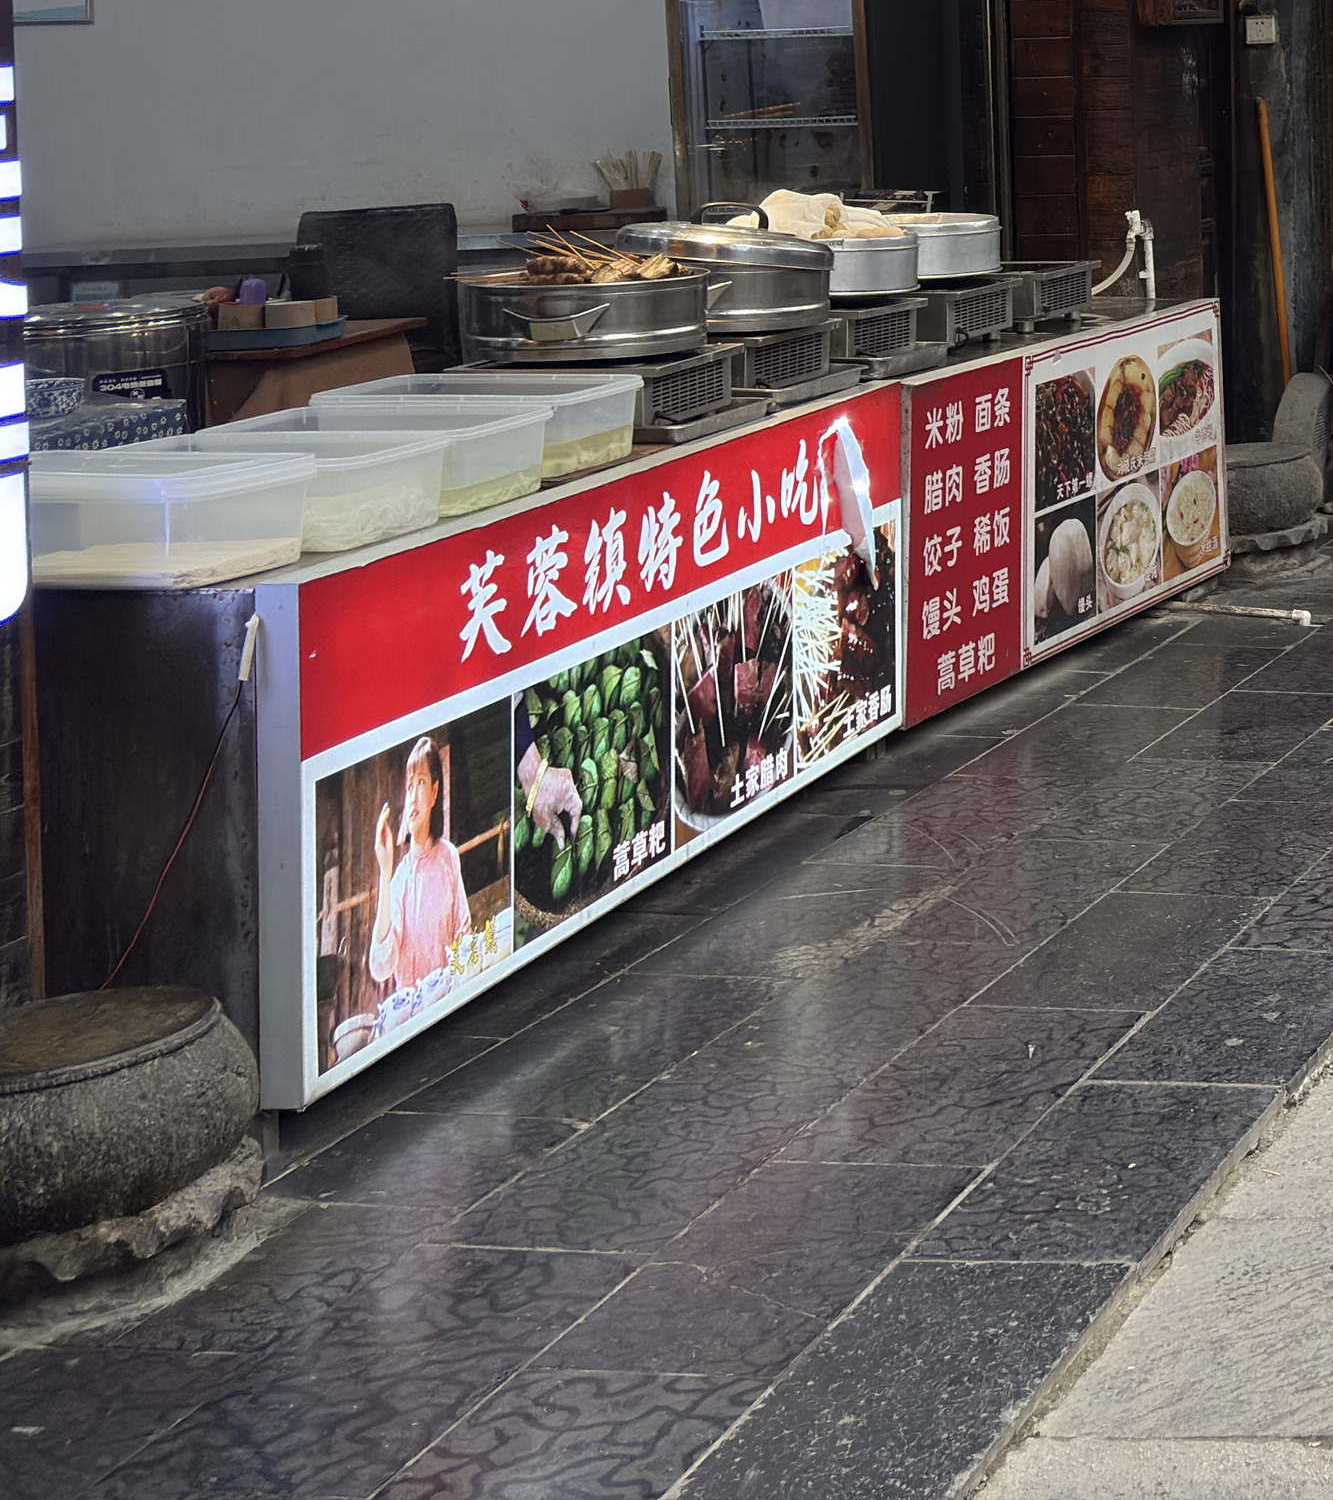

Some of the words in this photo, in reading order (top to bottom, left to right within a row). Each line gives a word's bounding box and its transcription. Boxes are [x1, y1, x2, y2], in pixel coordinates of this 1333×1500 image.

[924, 399, 964, 450] 米粉
[974, 387, 1011, 434] 面条
[923, 463, 963, 516] 腊肉
[973, 447, 1010, 496] 香肠
[922, 525, 963, 577] 饺子
[972, 506, 1010, 557] 稀饭
[921, 587, 962, 640] 馒头
[972, 566, 1010, 617] 鸡蛋
[936, 632, 996, 696] 蒿草粑
[842, 684, 892, 740] 土家香肠
[730, 746, 788, 809] 土家腊肉
[612, 820, 666, 882] 蒿草粑
